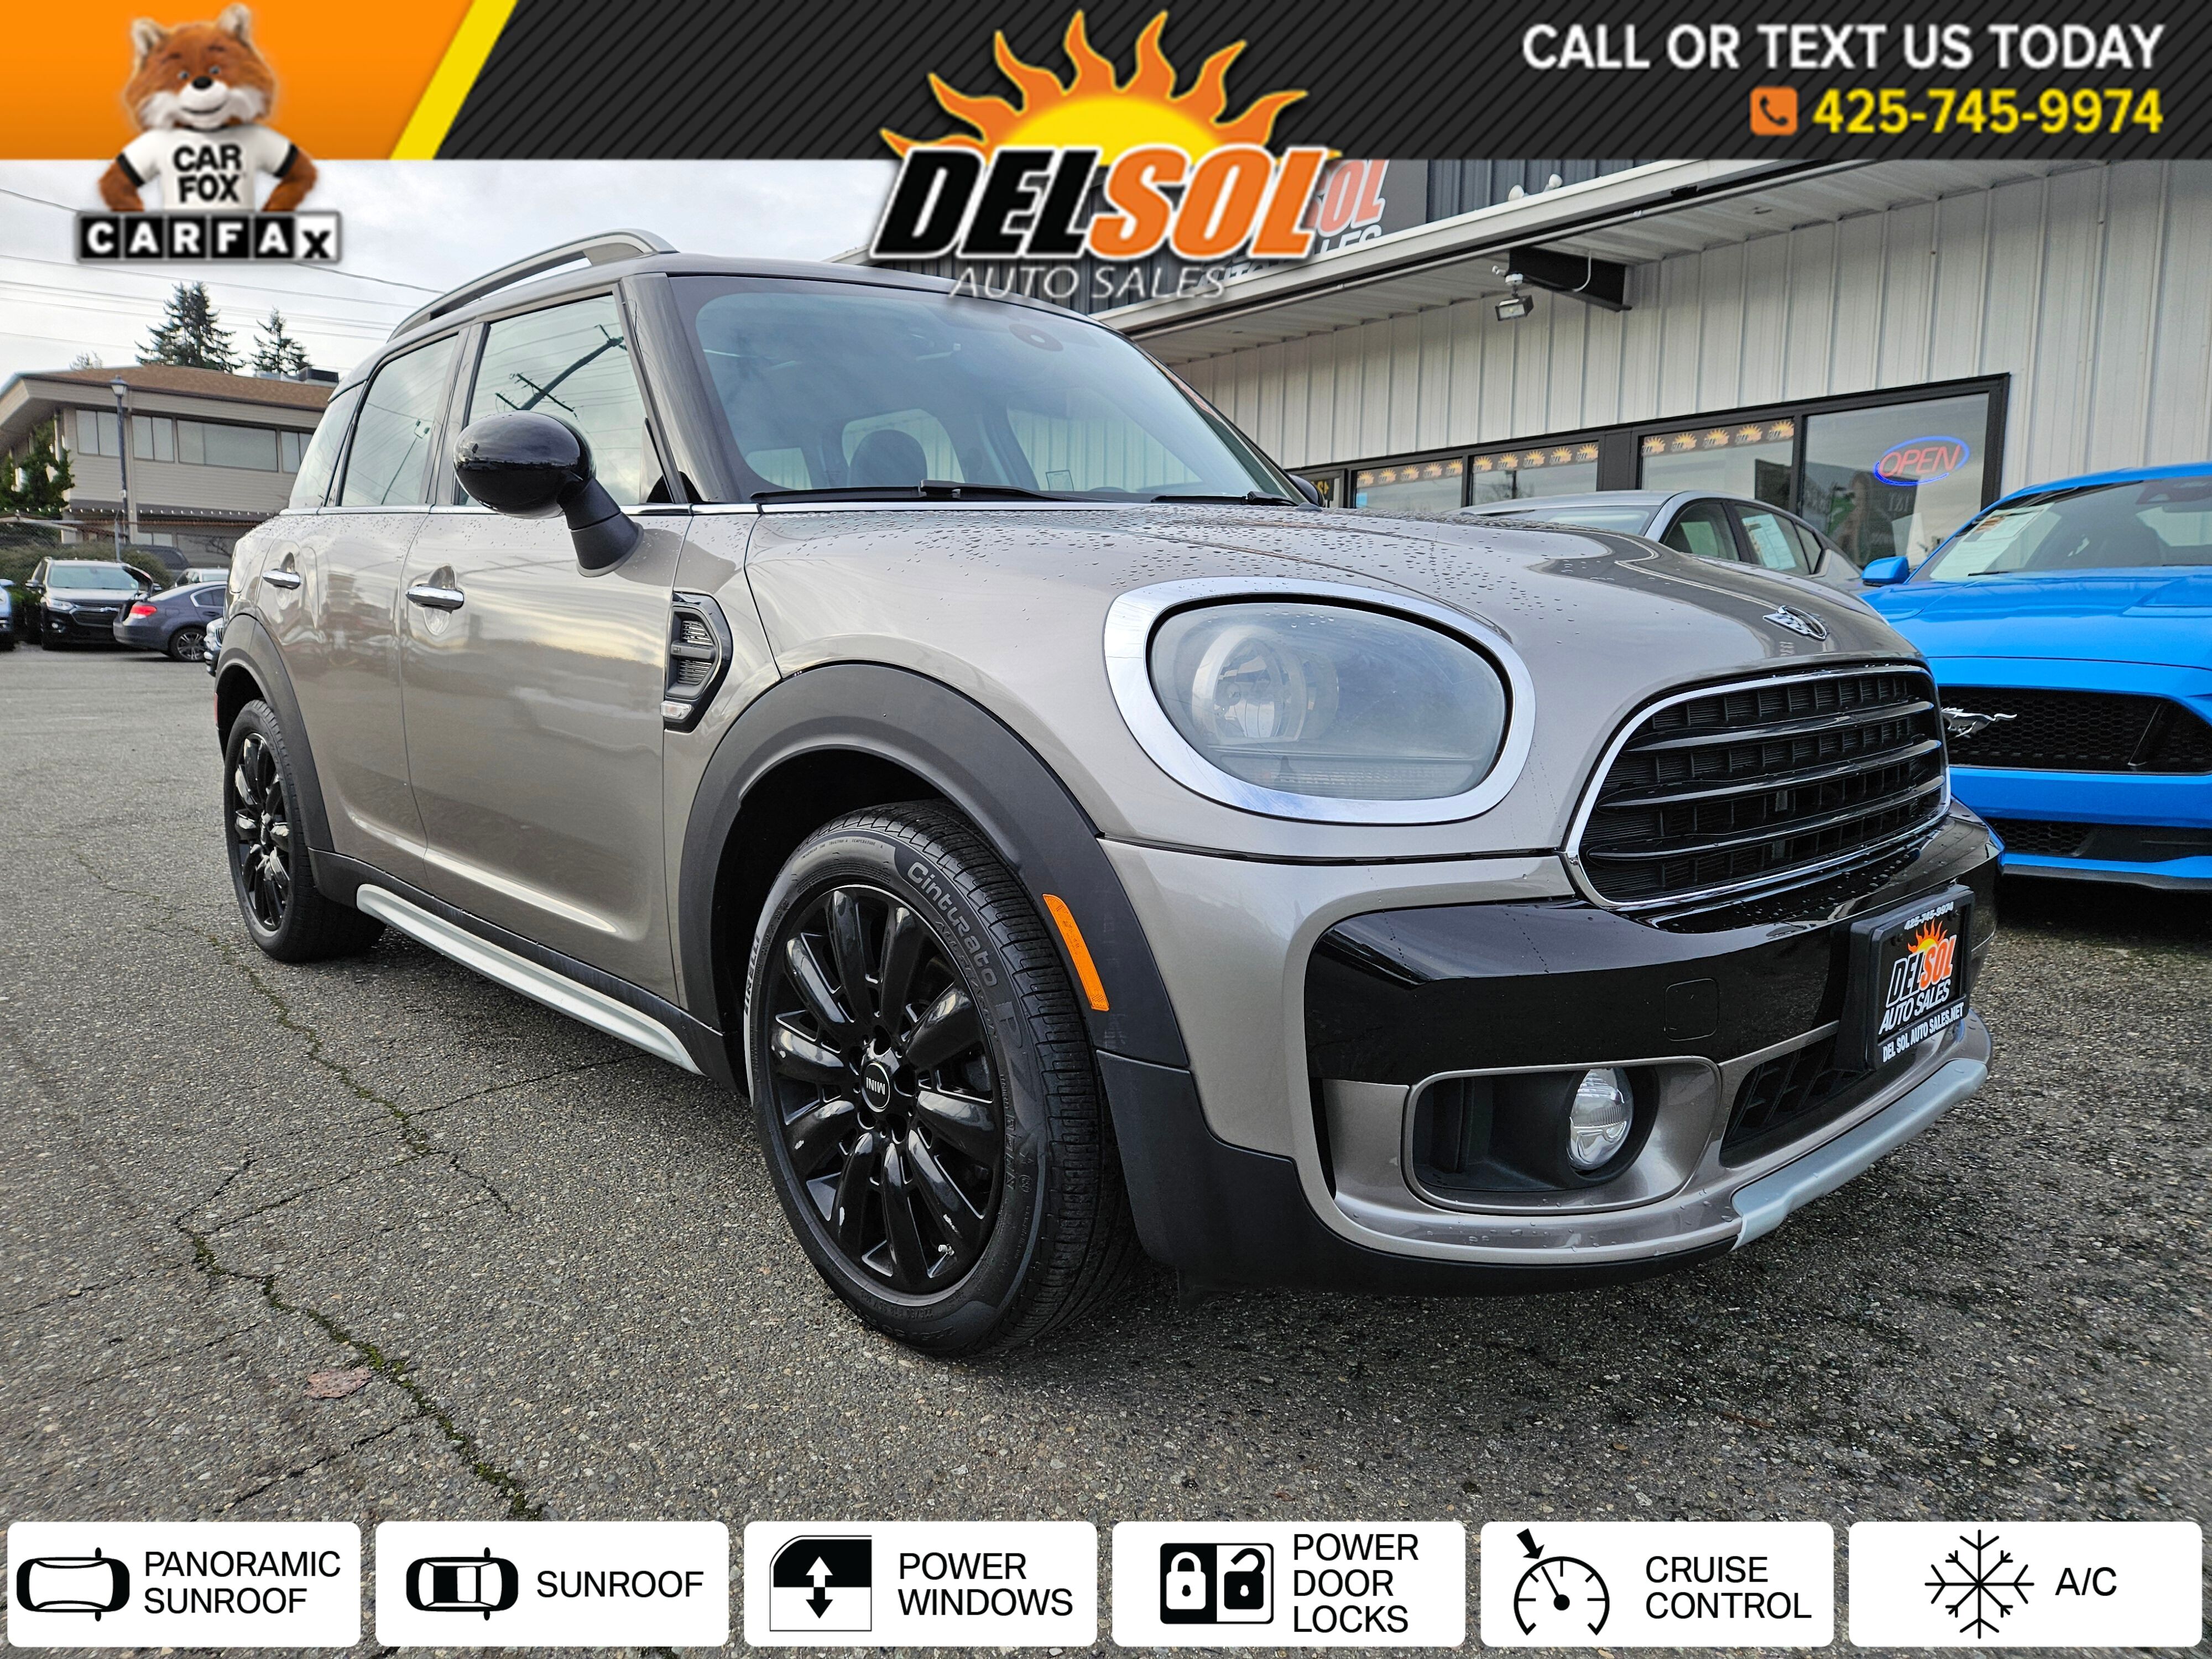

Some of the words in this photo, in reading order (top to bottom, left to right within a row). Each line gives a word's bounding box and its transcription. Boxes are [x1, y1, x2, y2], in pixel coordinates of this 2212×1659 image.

[1880, 445, 1962, 478] OPEN
[907, 861, 998, 987] Cinturato
[1904, 901, 1954, 930] 425-745-9974
[1879, 997, 1914, 1035] AUTO
[1914, 979, 1951, 1016] SALES
[1882, 1044, 1896, 1063] DEL
[1896, 1034, 1910, 1052] SOL
[1910, 1025, 1928, 1044] AUTO
[1928, 1003, 1964, 1033] SALES.NET
[866, 1077, 885, 1095] MINI
